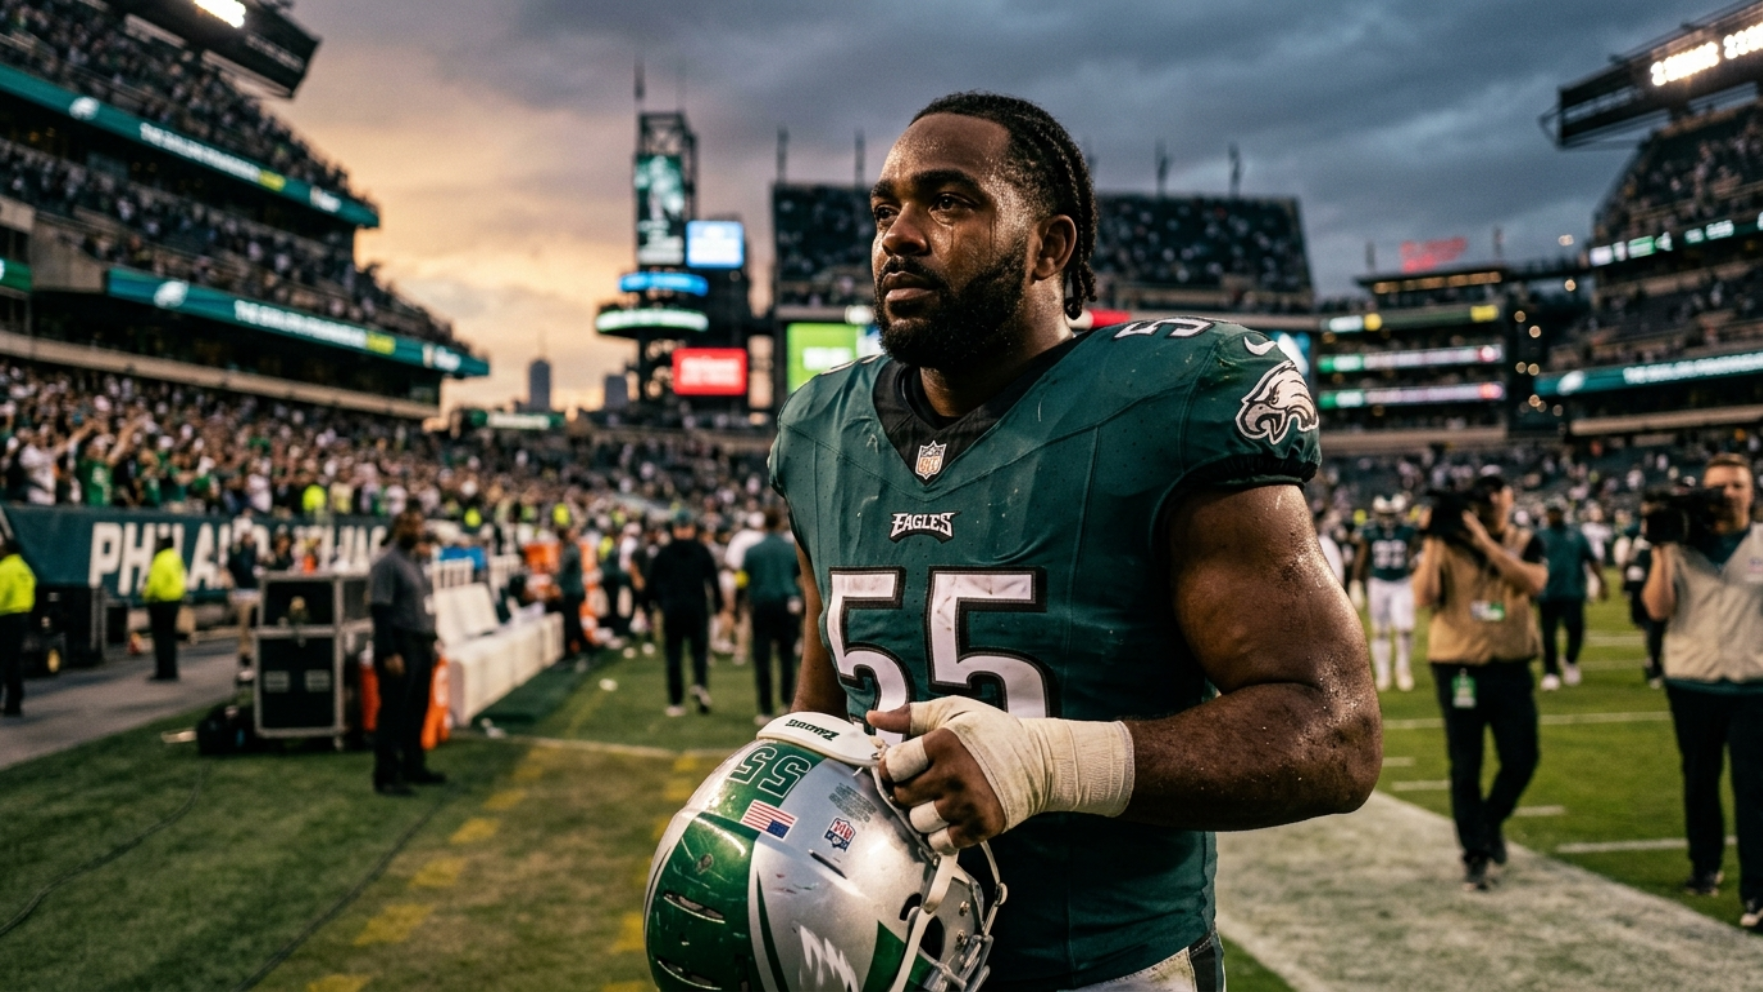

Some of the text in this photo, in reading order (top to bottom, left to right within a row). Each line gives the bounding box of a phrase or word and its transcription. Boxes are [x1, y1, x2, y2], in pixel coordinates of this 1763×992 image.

[889, 512, 957, 539] EAGLES
[826, 568, 1056, 741] 55
[728, 746, 812, 798] 55
